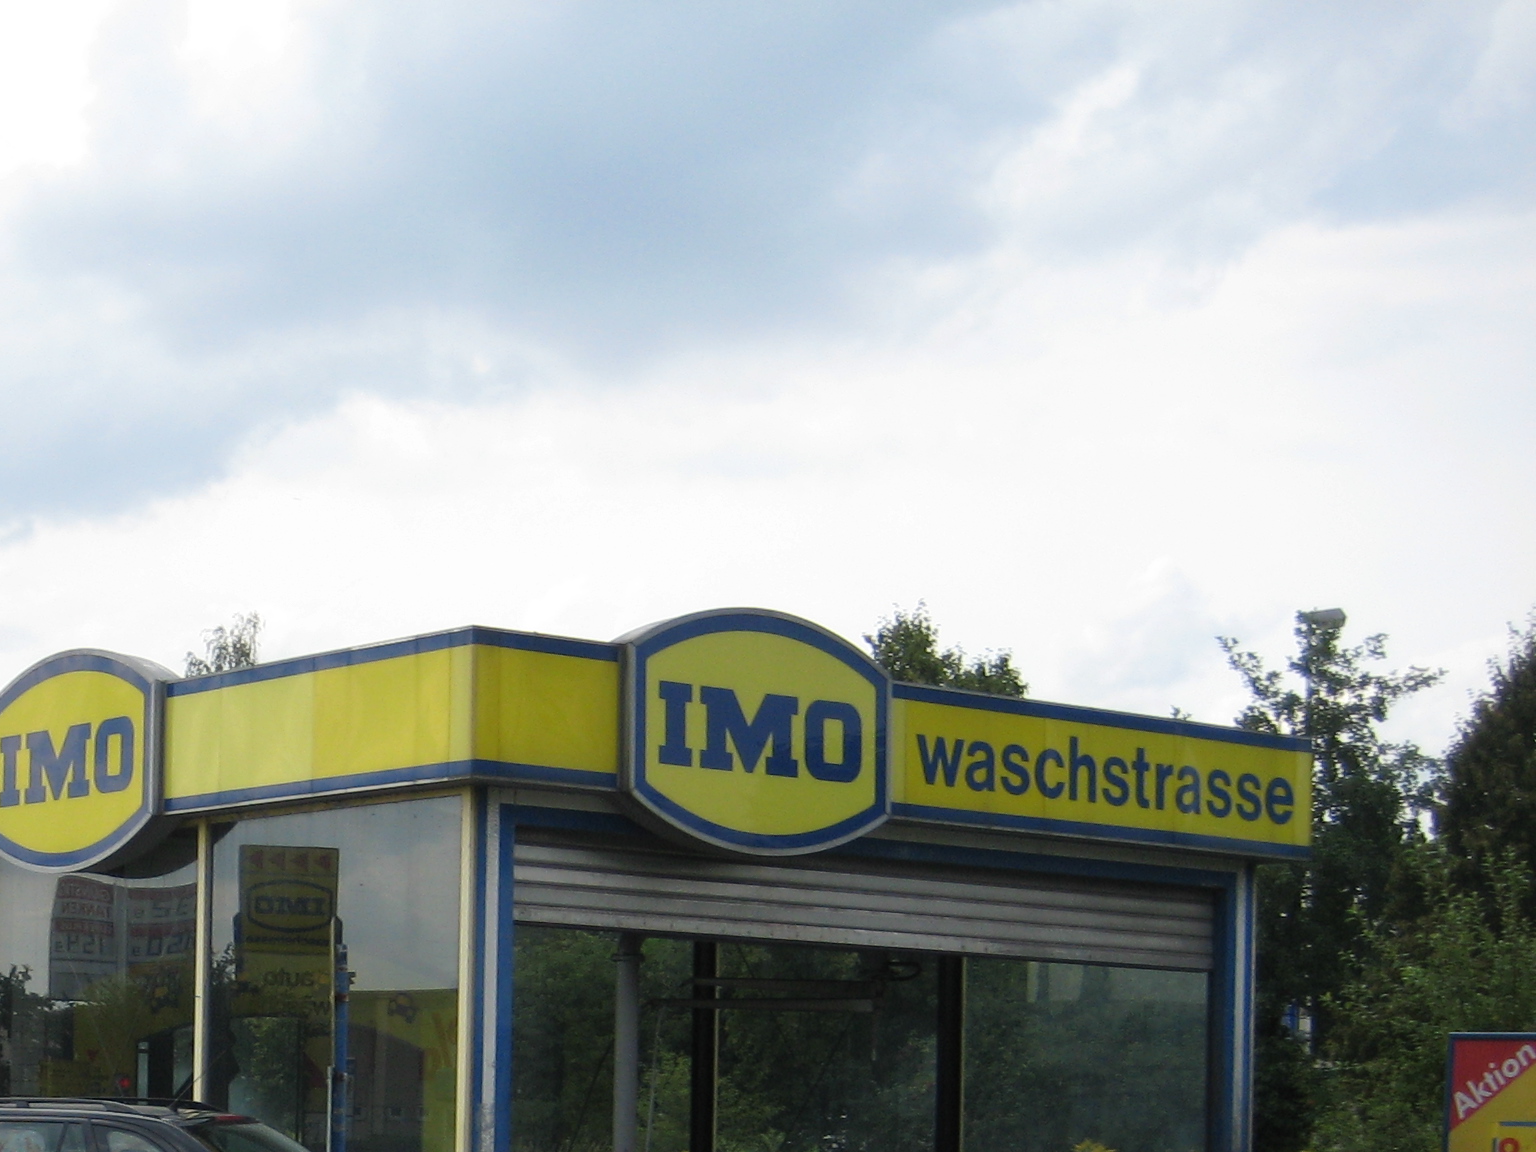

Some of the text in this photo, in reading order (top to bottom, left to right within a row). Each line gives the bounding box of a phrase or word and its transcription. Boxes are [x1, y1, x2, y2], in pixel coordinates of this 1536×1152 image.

[0, 716, 135, 808] IMO
[658, 680, 862, 783] IMO
[916, 732, 1295, 826] waschstrasse
[1453, 1043, 1536, 1119] Aktion
